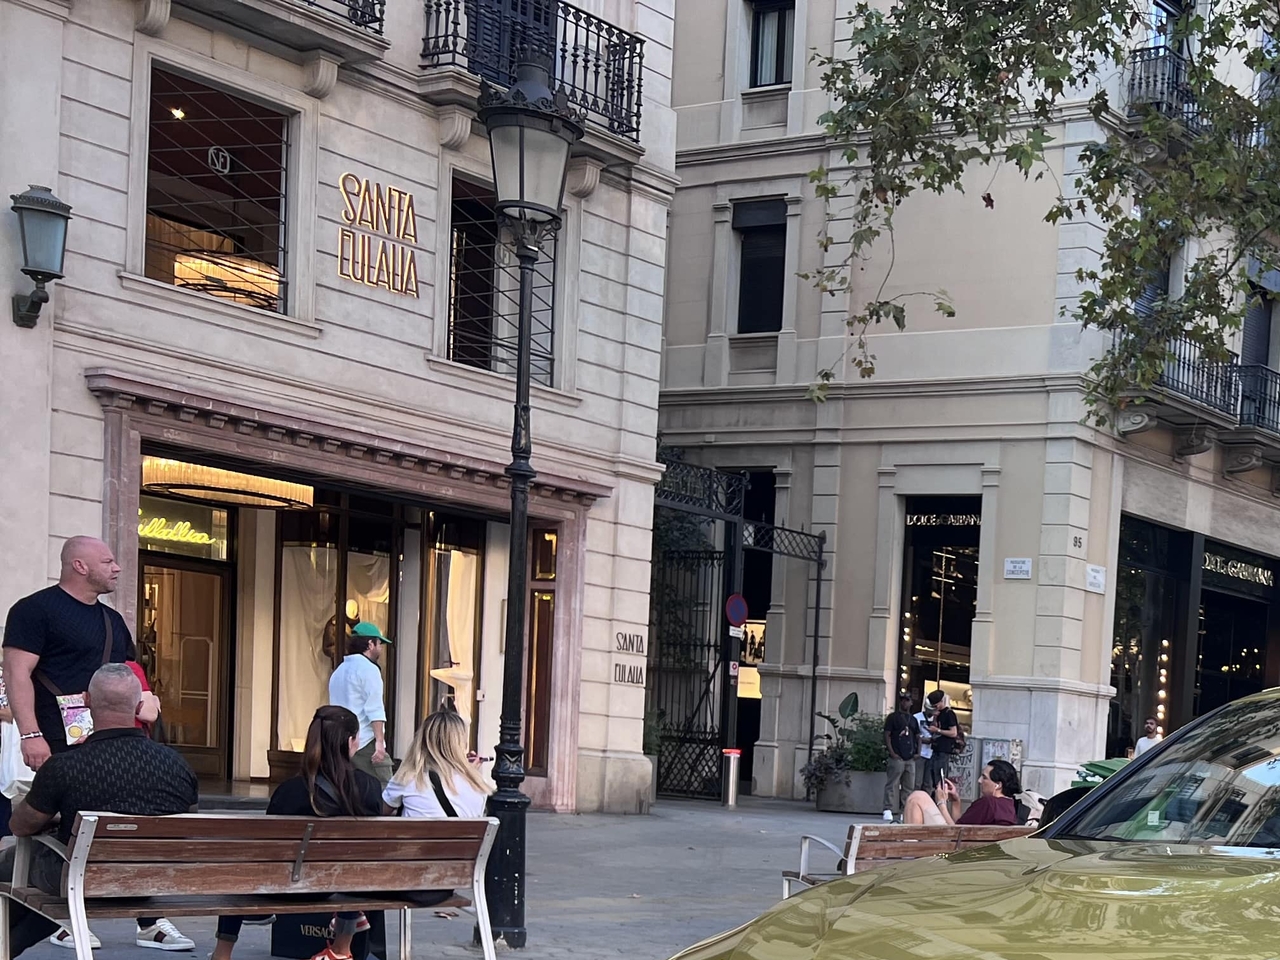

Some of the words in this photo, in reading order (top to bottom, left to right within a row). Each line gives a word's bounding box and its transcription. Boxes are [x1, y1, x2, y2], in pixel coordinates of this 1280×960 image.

[339, 172, 417, 244] SANTA
[338, 226, 419, 299] EULALIA
[1073, 536, 1082, 548] 95
[616, 632, 644, 653] SANTA
[614, 663, 643, 684] EULALIA
[300, 924, 335, 939] VERSACE
